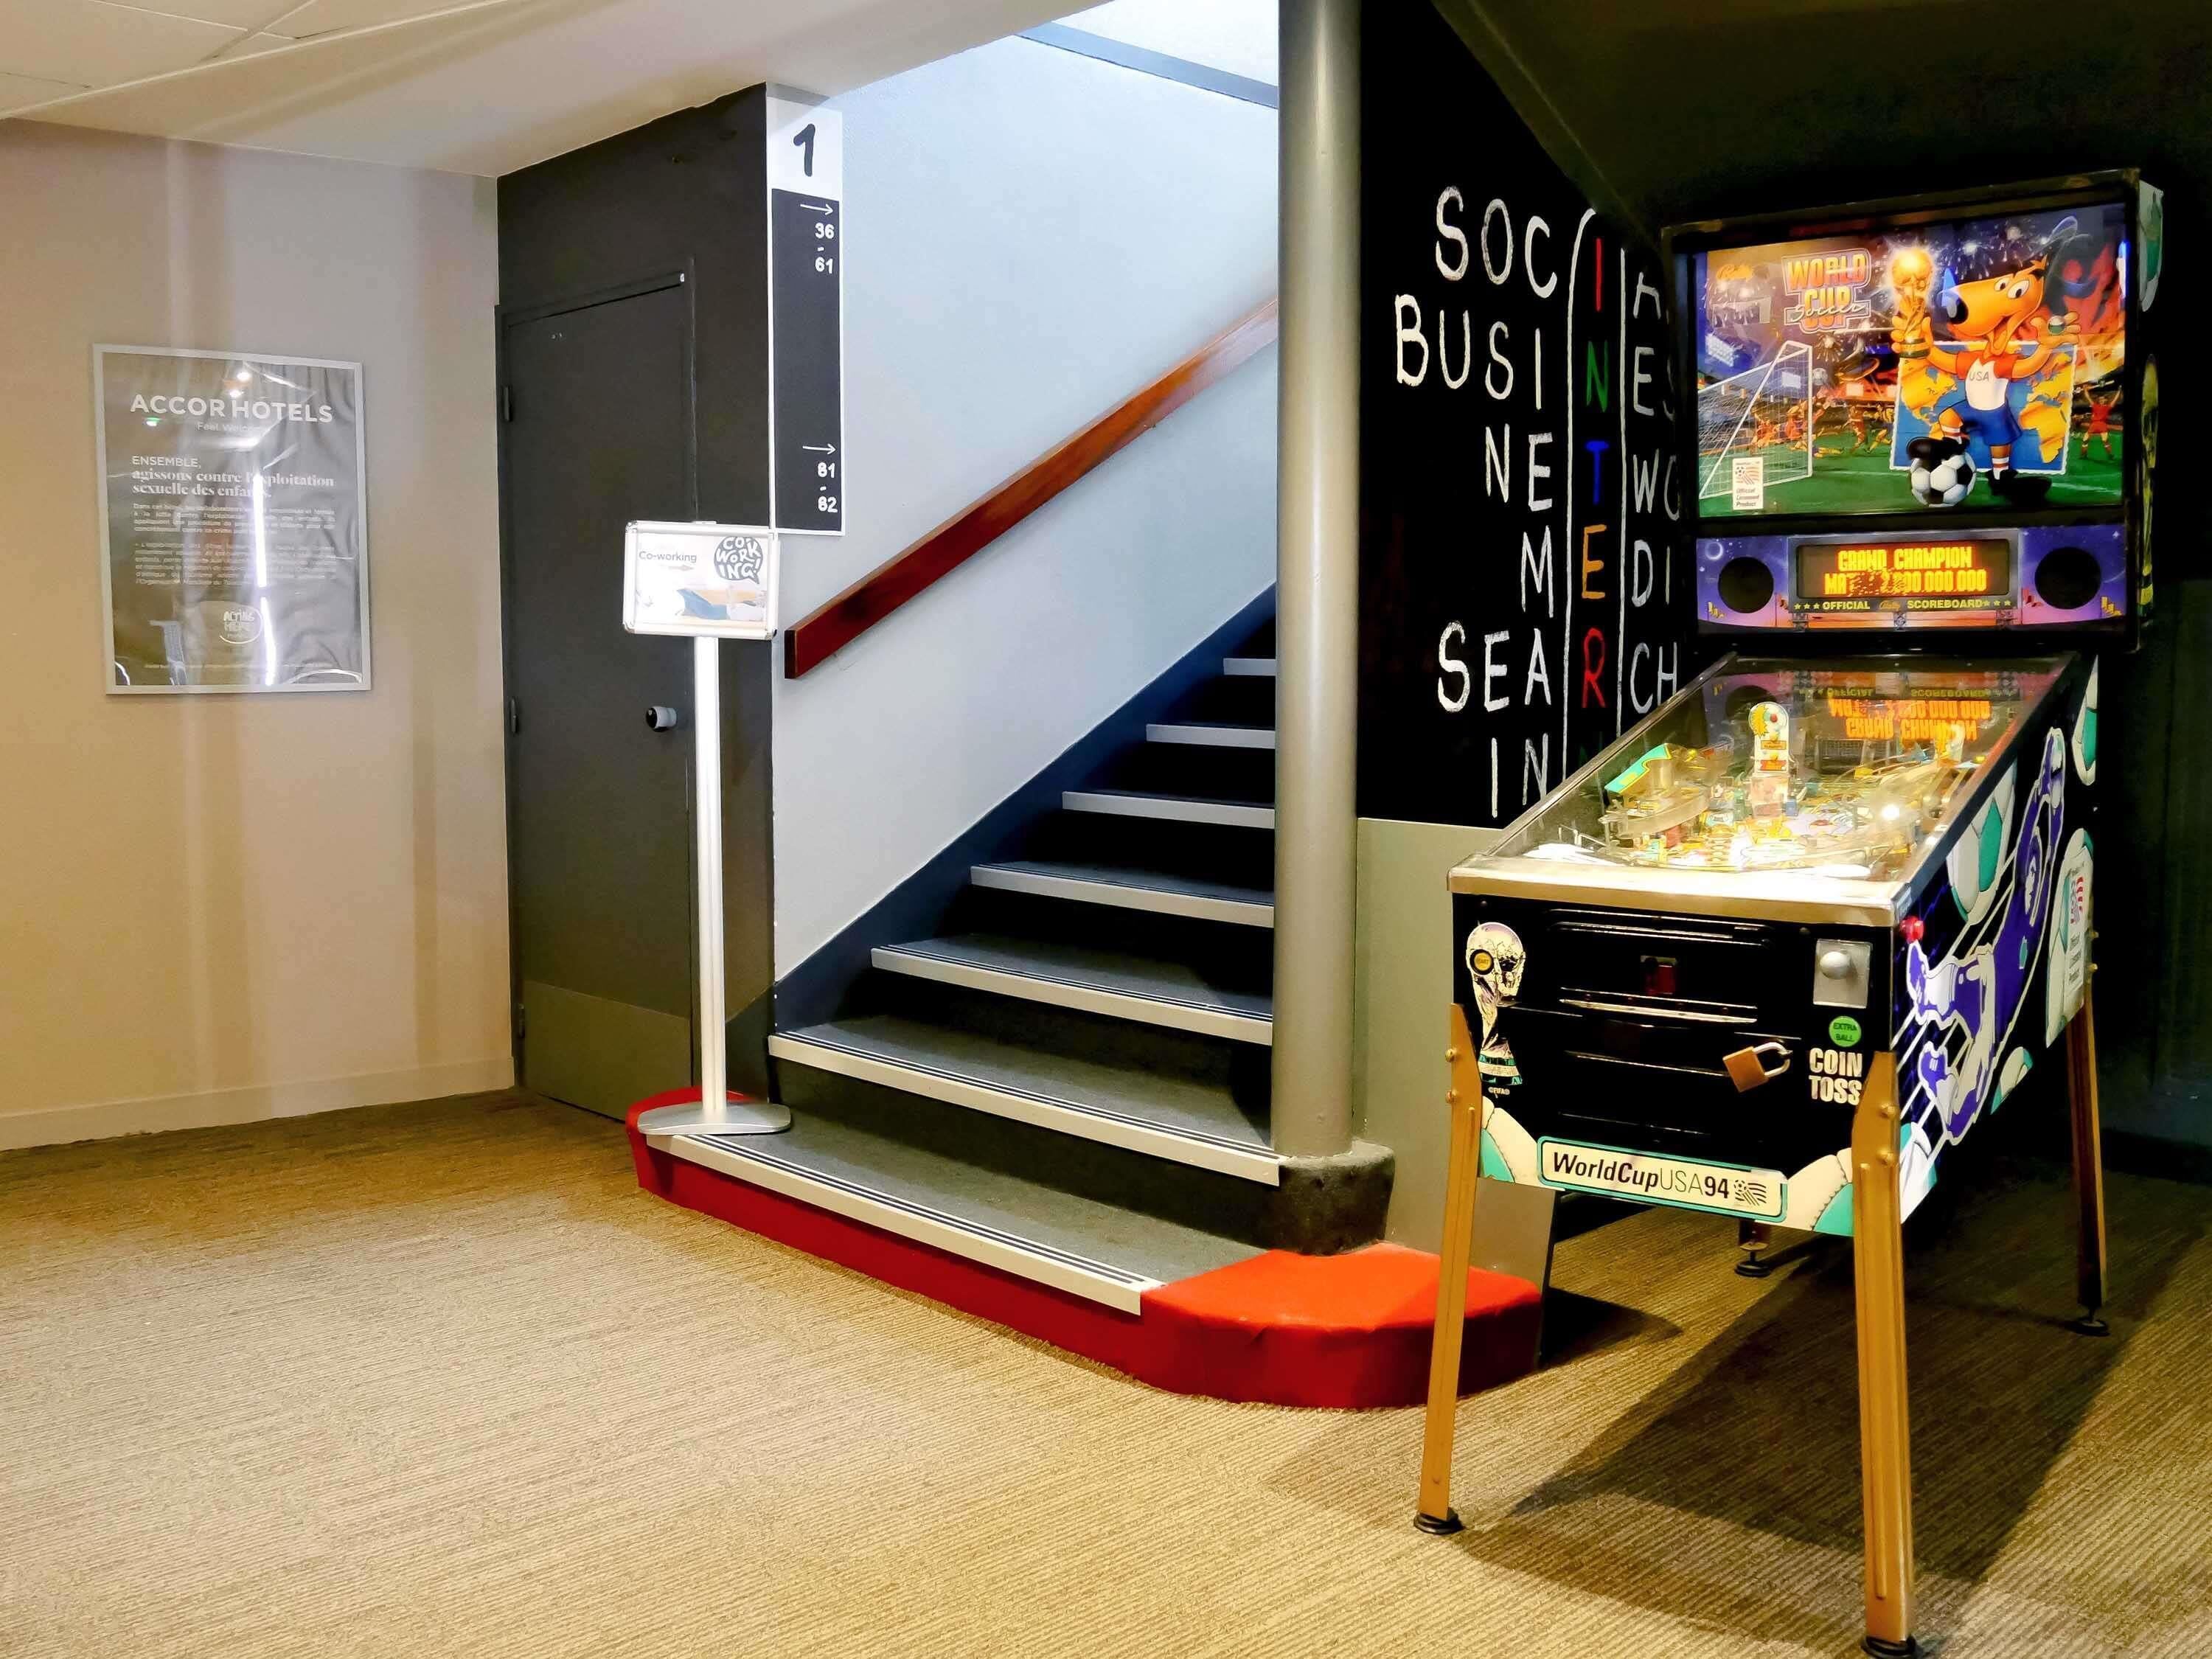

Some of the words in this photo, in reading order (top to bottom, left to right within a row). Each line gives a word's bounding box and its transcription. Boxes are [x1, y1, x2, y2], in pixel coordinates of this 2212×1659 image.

[793, 123, 816, 177] 1
[815, 222, 835, 239] 36
[815, 256, 833, 274] 61
[1787, 253, 1867, 290] WORLD
[1804, 285, 1851, 328] CUP
[1969, 371, 1990, 382] USA
[131, 455, 201, 468] ENSEMBLE,
[131, 467, 192, 482] agissons
[195, 471, 242, 483] contre
[818, 462, 835, 479] 81
[131, 482, 189, 495] sexuelle
[191, 484, 216, 495] des
[818, 495, 838, 513] 82
[639, 550, 698, 563] Co-working
[1838, 549, 1888, 571] GRAND
[1893, 546, 1973, 571] CHAMPION
[1822, 600, 1871, 611] OFFICIAL
[1907, 599, 1983, 610] SCOREBOARD
[1833, 1023, 1858, 1032] EXTRA
[1809, 1047, 1863, 1078] COIN
[1808, 1074, 1863, 1106] TOSS
